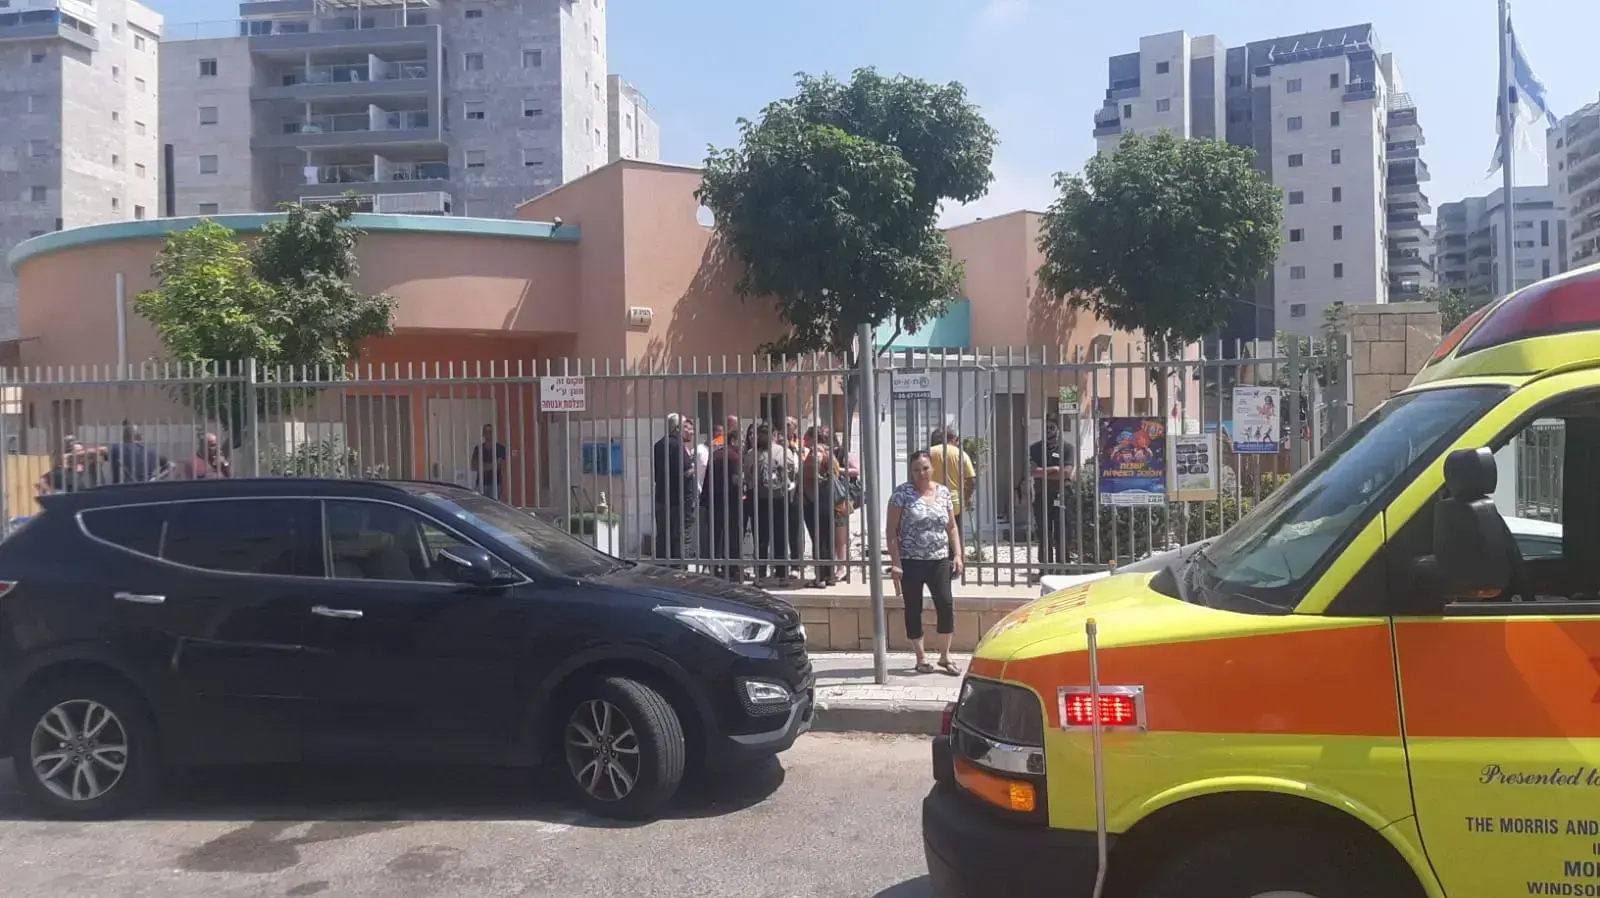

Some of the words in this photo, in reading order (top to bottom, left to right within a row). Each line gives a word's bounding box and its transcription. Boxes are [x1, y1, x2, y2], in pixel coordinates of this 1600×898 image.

[566, 378, 583, 386] מקום
[570, 388, 583, 396] מוגן
[541, 400, 562, 409] אבטחה
[563, 398, 584, 409] מצלמת
[1479, 763, 1584, 785] Presented
[1465, 817, 1493, 832] THE
[1500, 818, 1559, 834] MORRIS
[1566, 820, 1599, 836] AND
[1563, 861, 1600, 878] MO
[1527, 882, 1600, 897] WINDSO
